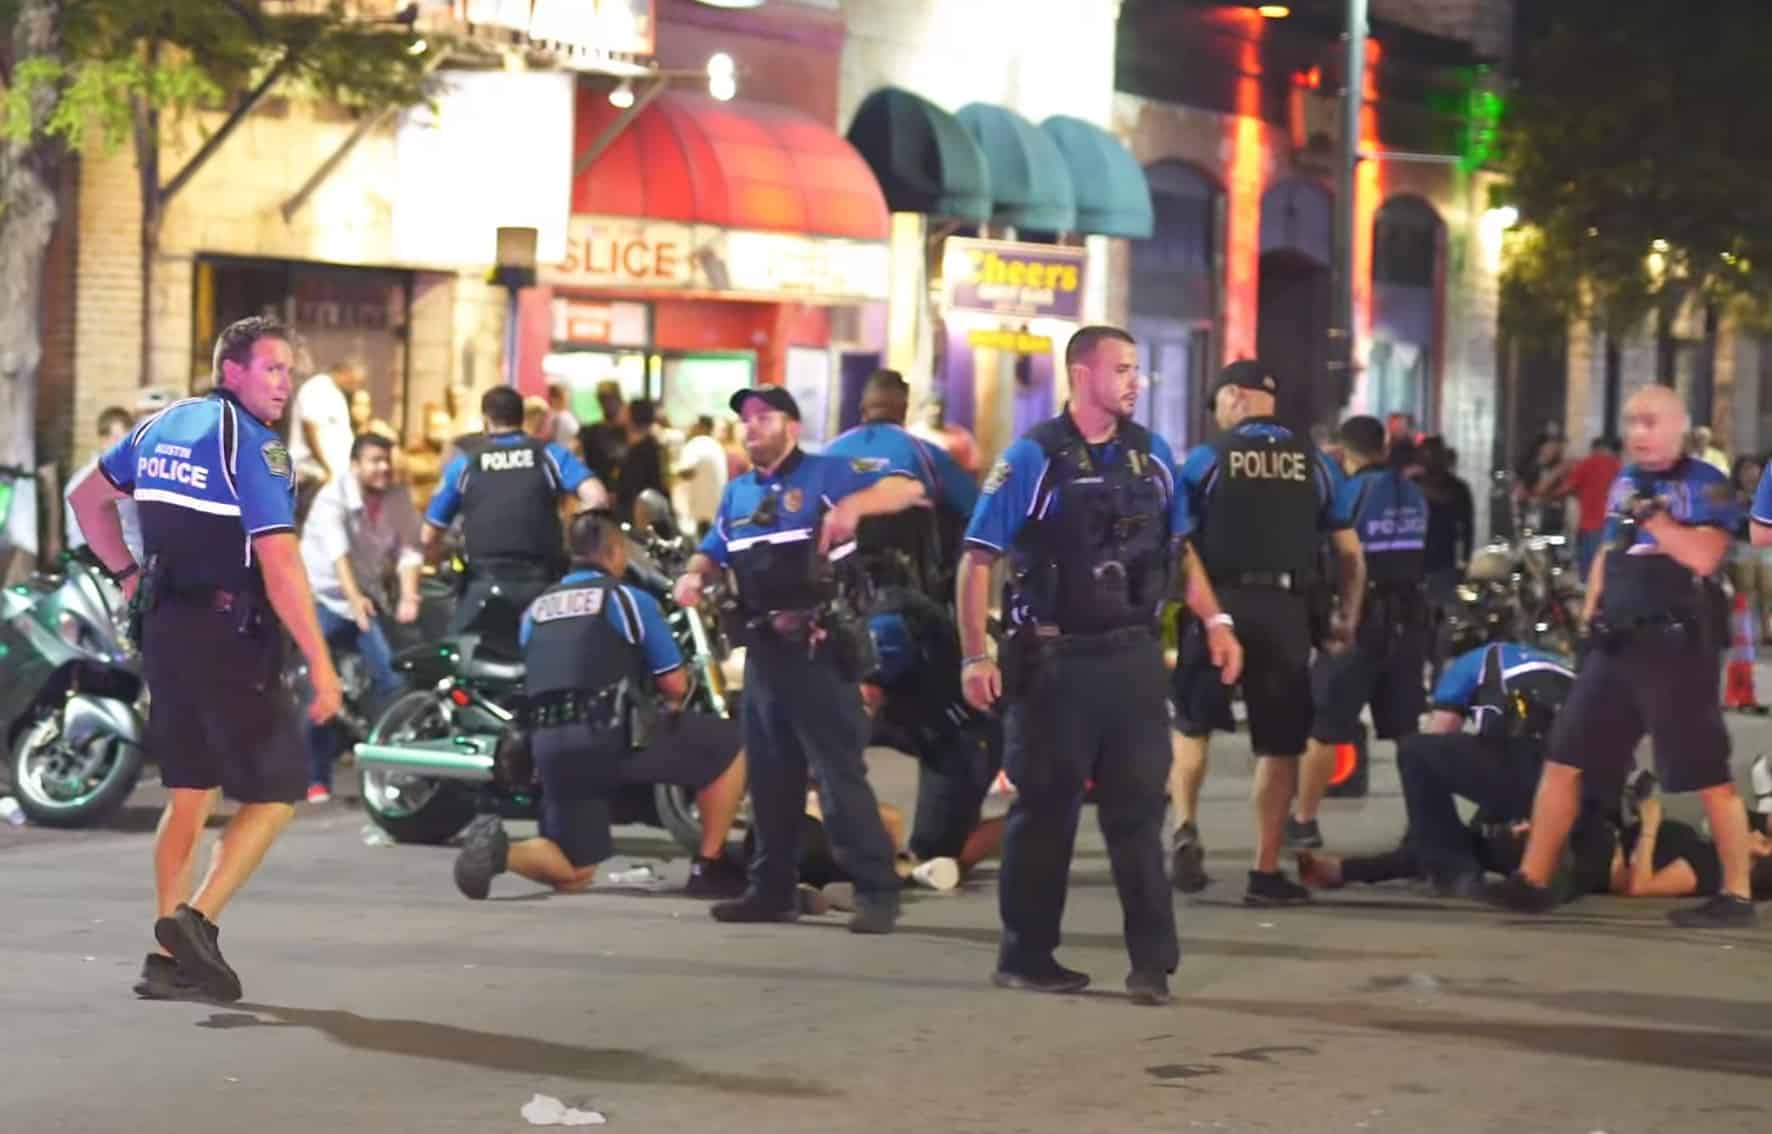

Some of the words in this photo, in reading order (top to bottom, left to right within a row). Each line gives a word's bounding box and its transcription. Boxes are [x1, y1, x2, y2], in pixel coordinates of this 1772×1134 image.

[555, 238, 676, 278] SLICE
[137, 456, 209, 489] POLICE
[481, 449, 534, 471] POLICE
[1229, 450, 1306, 482] POLICE
[536, 590, 597, 619] POLICE
